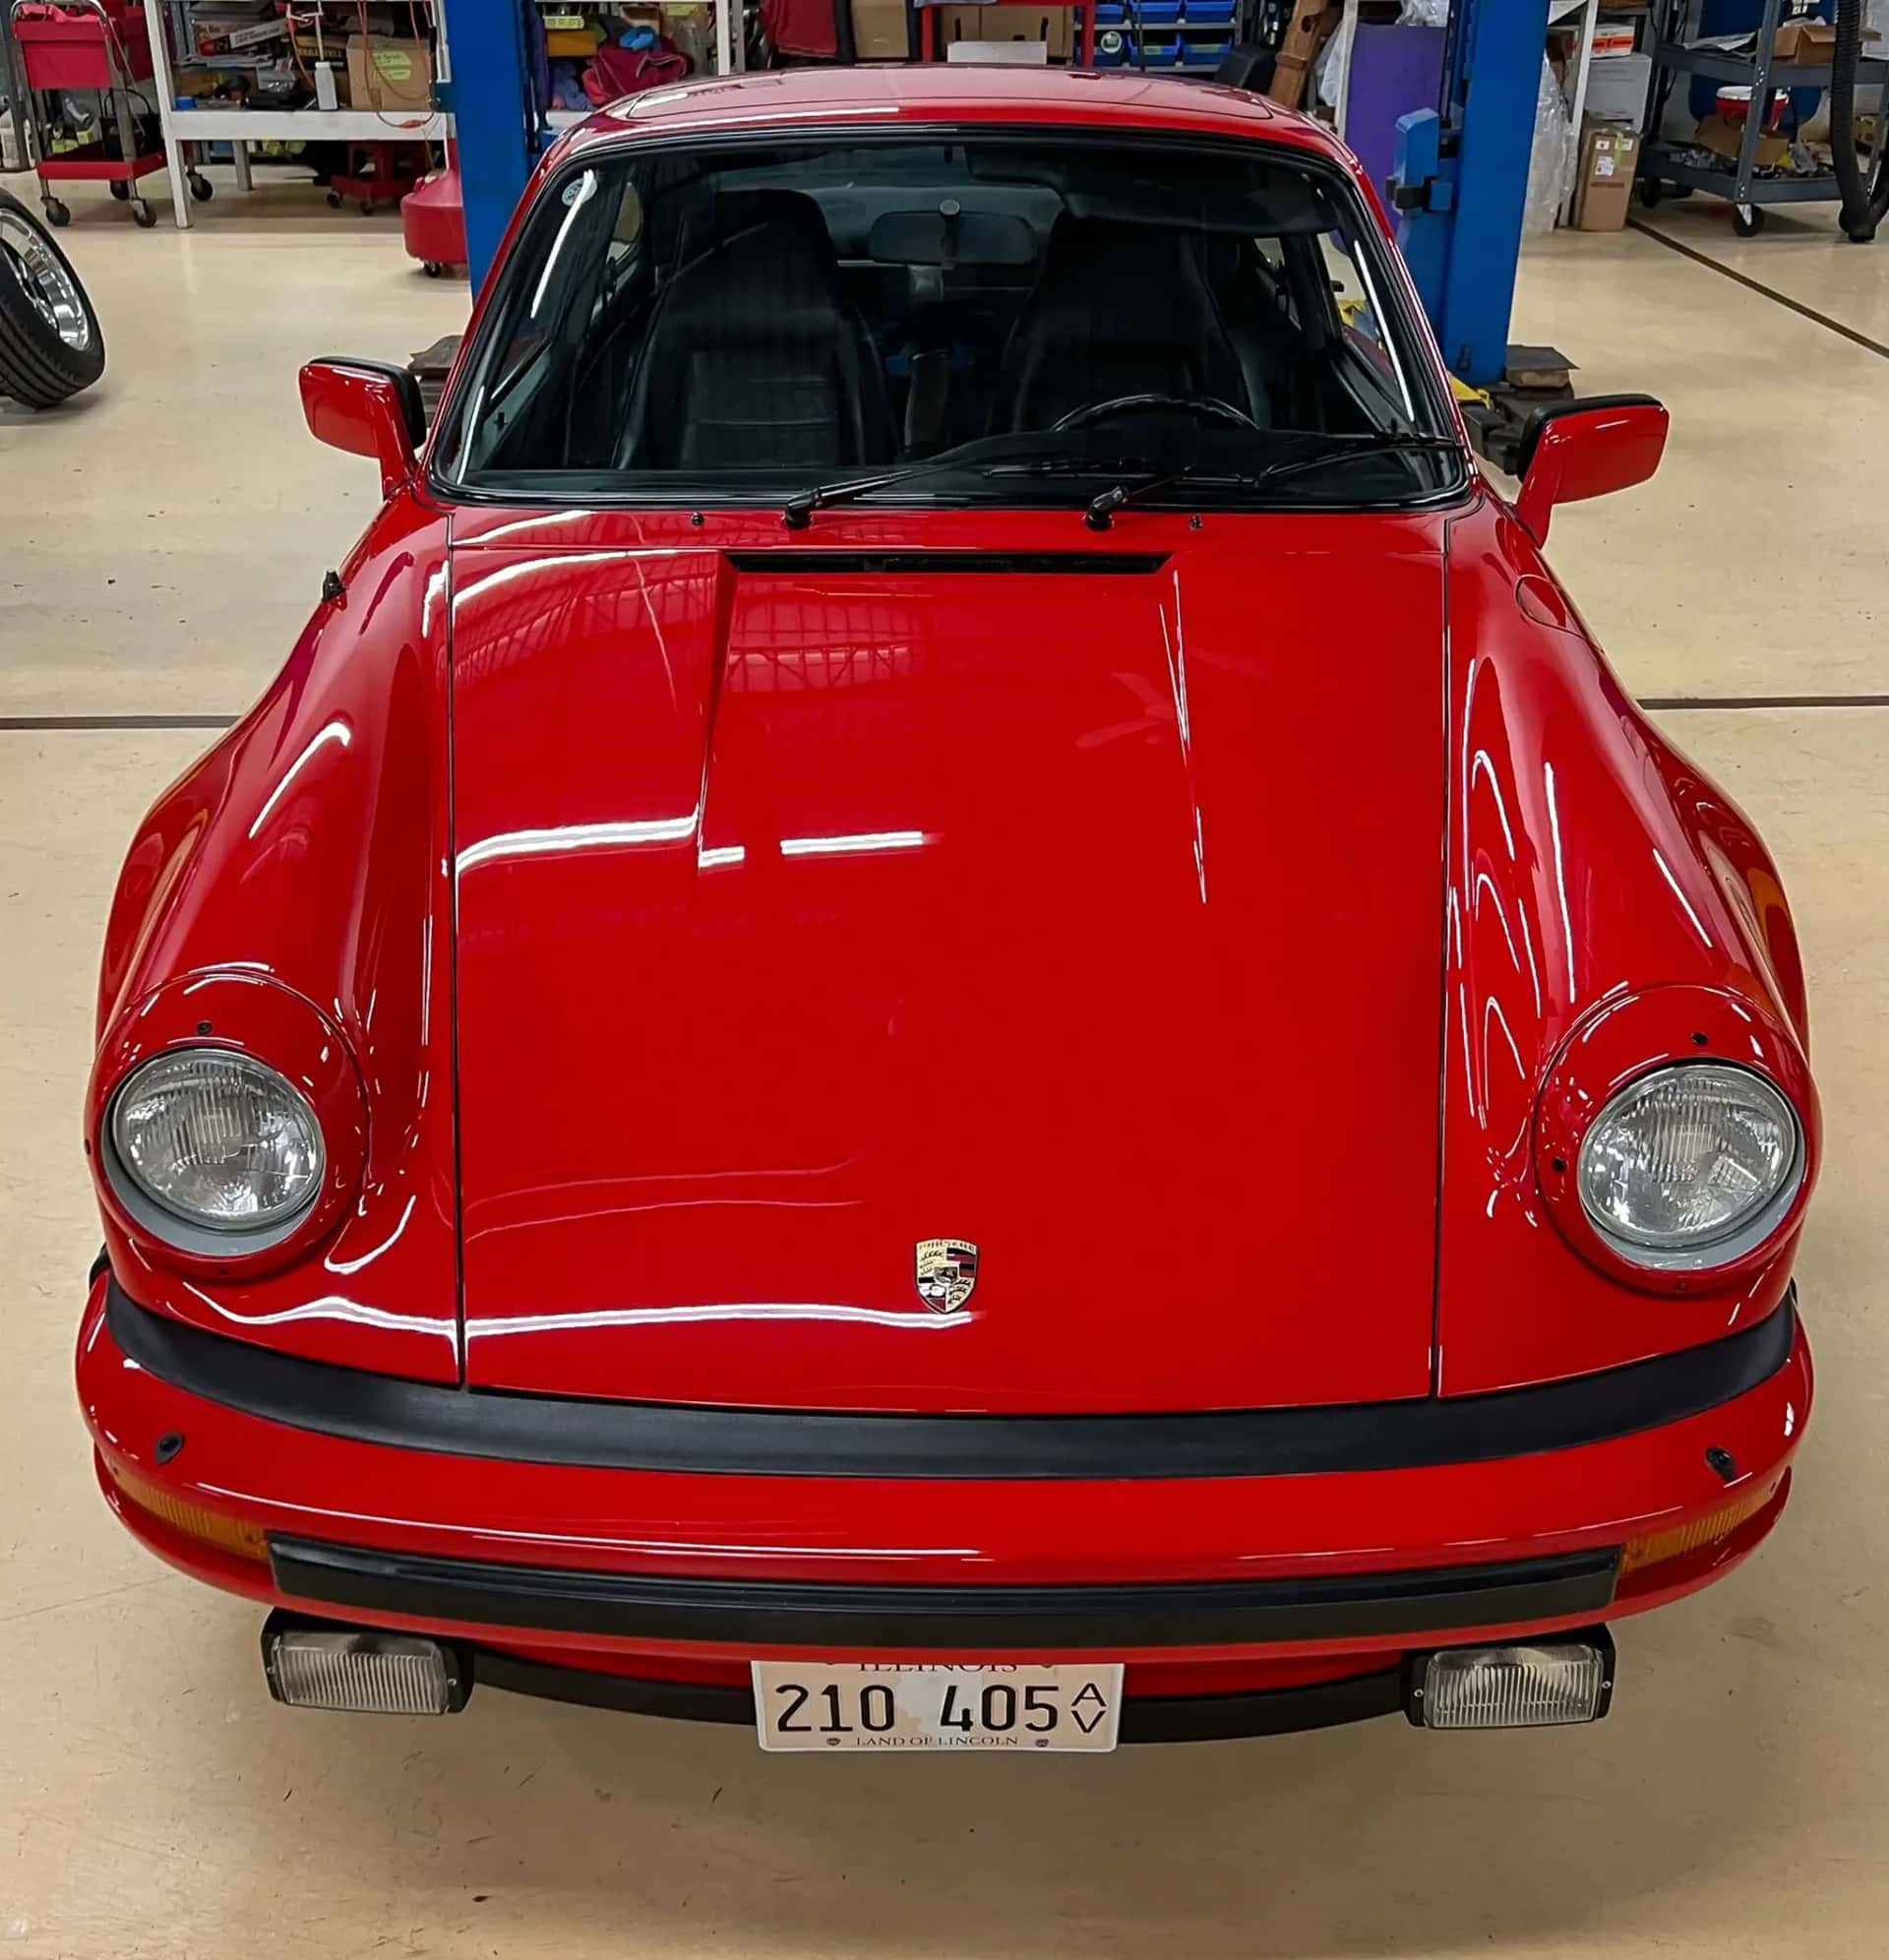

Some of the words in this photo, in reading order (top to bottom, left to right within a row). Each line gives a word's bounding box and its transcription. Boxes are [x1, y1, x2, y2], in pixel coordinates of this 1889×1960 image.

[776, 1684, 894, 1733] 210
[940, 1684, 1059, 1732] 405
[857, 1736, 905, 1746] LAND
[939, 1736, 1017, 1746] LINCOLN
